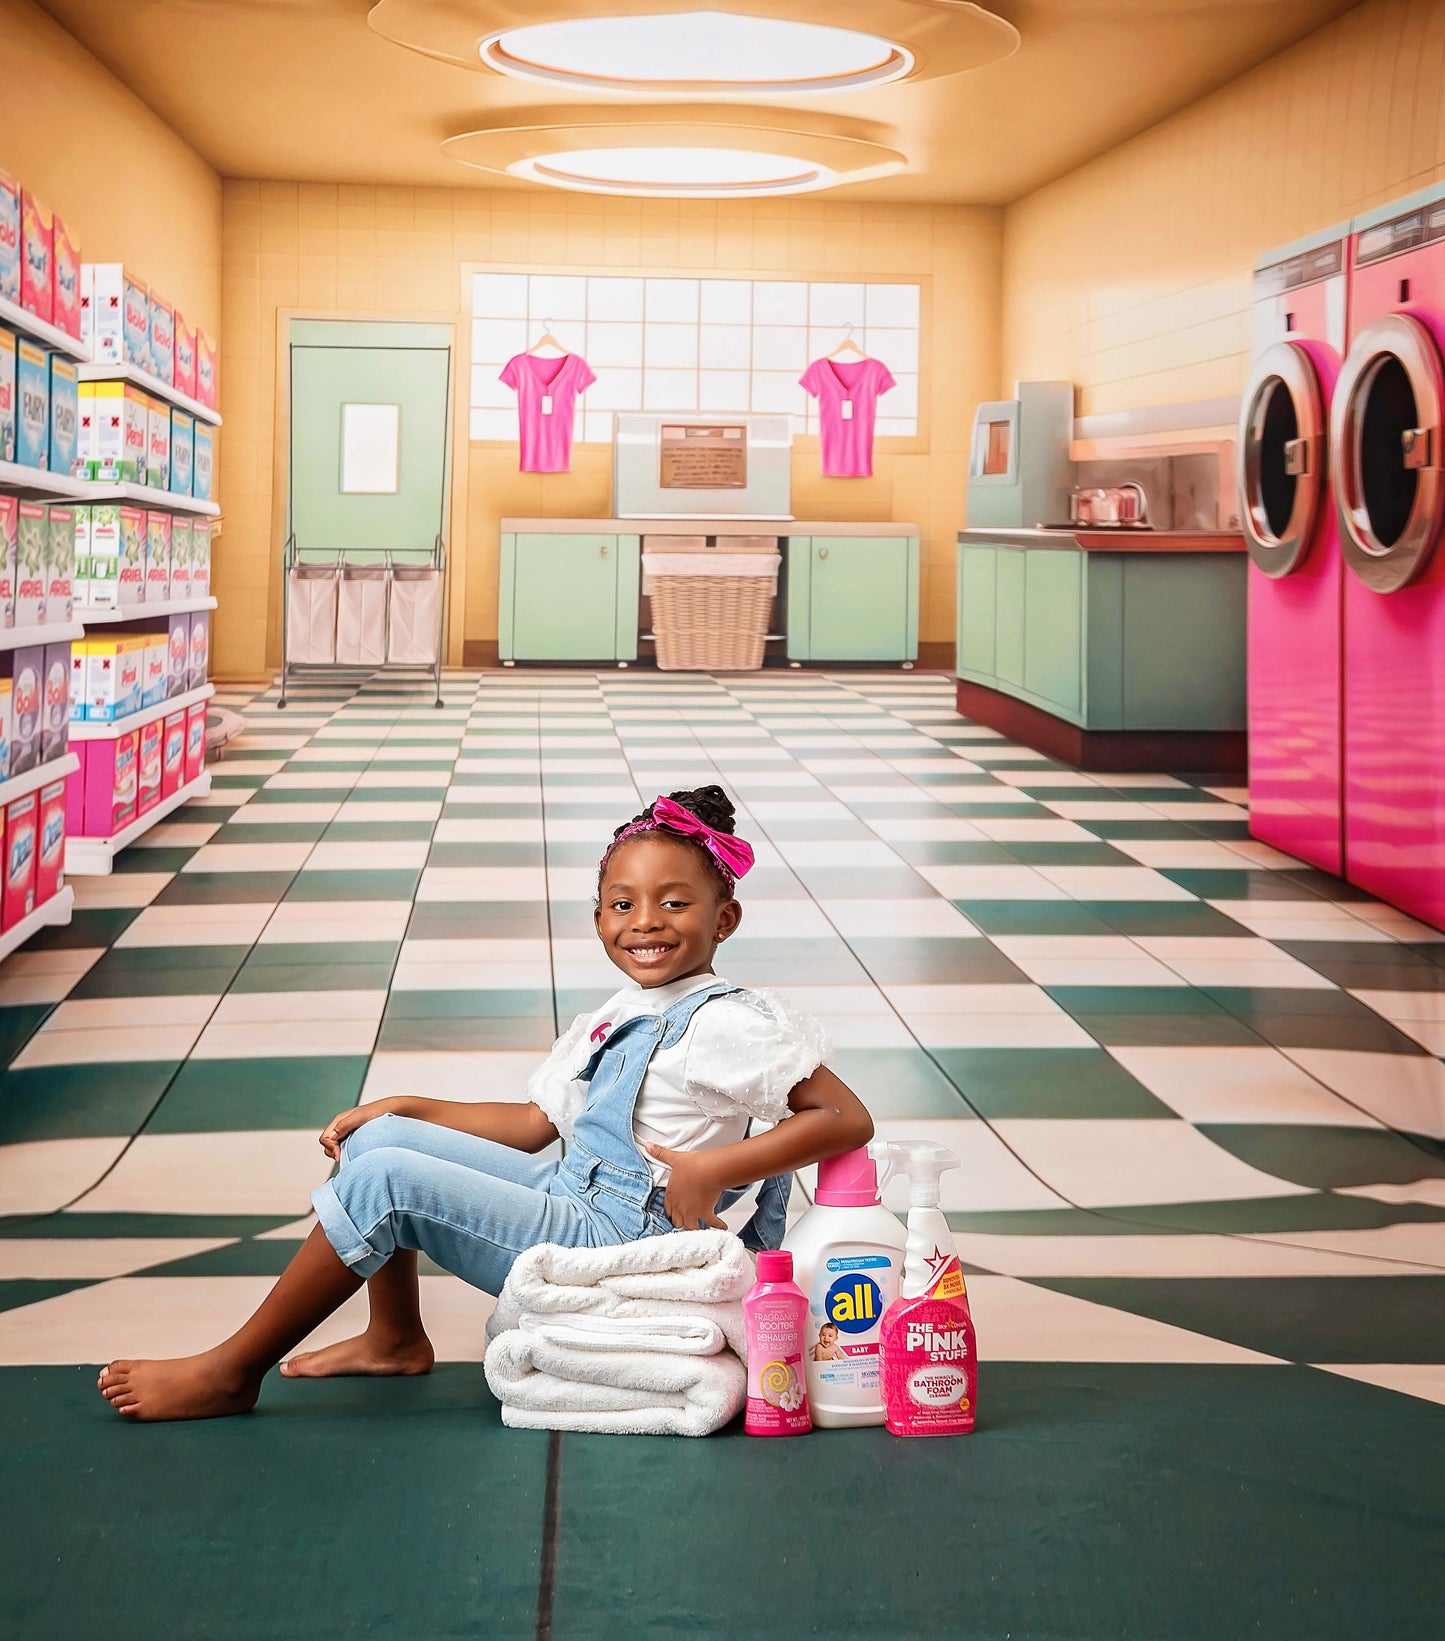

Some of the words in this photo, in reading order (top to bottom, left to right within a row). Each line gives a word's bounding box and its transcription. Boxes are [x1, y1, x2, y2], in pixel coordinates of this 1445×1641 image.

[119, 567, 143, 582] ARIEL
[147, 568, 168, 581] ARIEL
[18, 579, 45, 598] ARIEL
[49, 579, 73, 598] ARIEL
[832, 1283, 873, 1322] all
[907, 1322, 934, 1333] THE
[906, 1329, 967, 1352] PINK
[852, 1346, 869, 1354] BABY
[930, 1349, 968, 1362] STUFF
[913, 1378, 964, 1387] BATHROOM
[927, 1386, 953, 1394] FOAM
